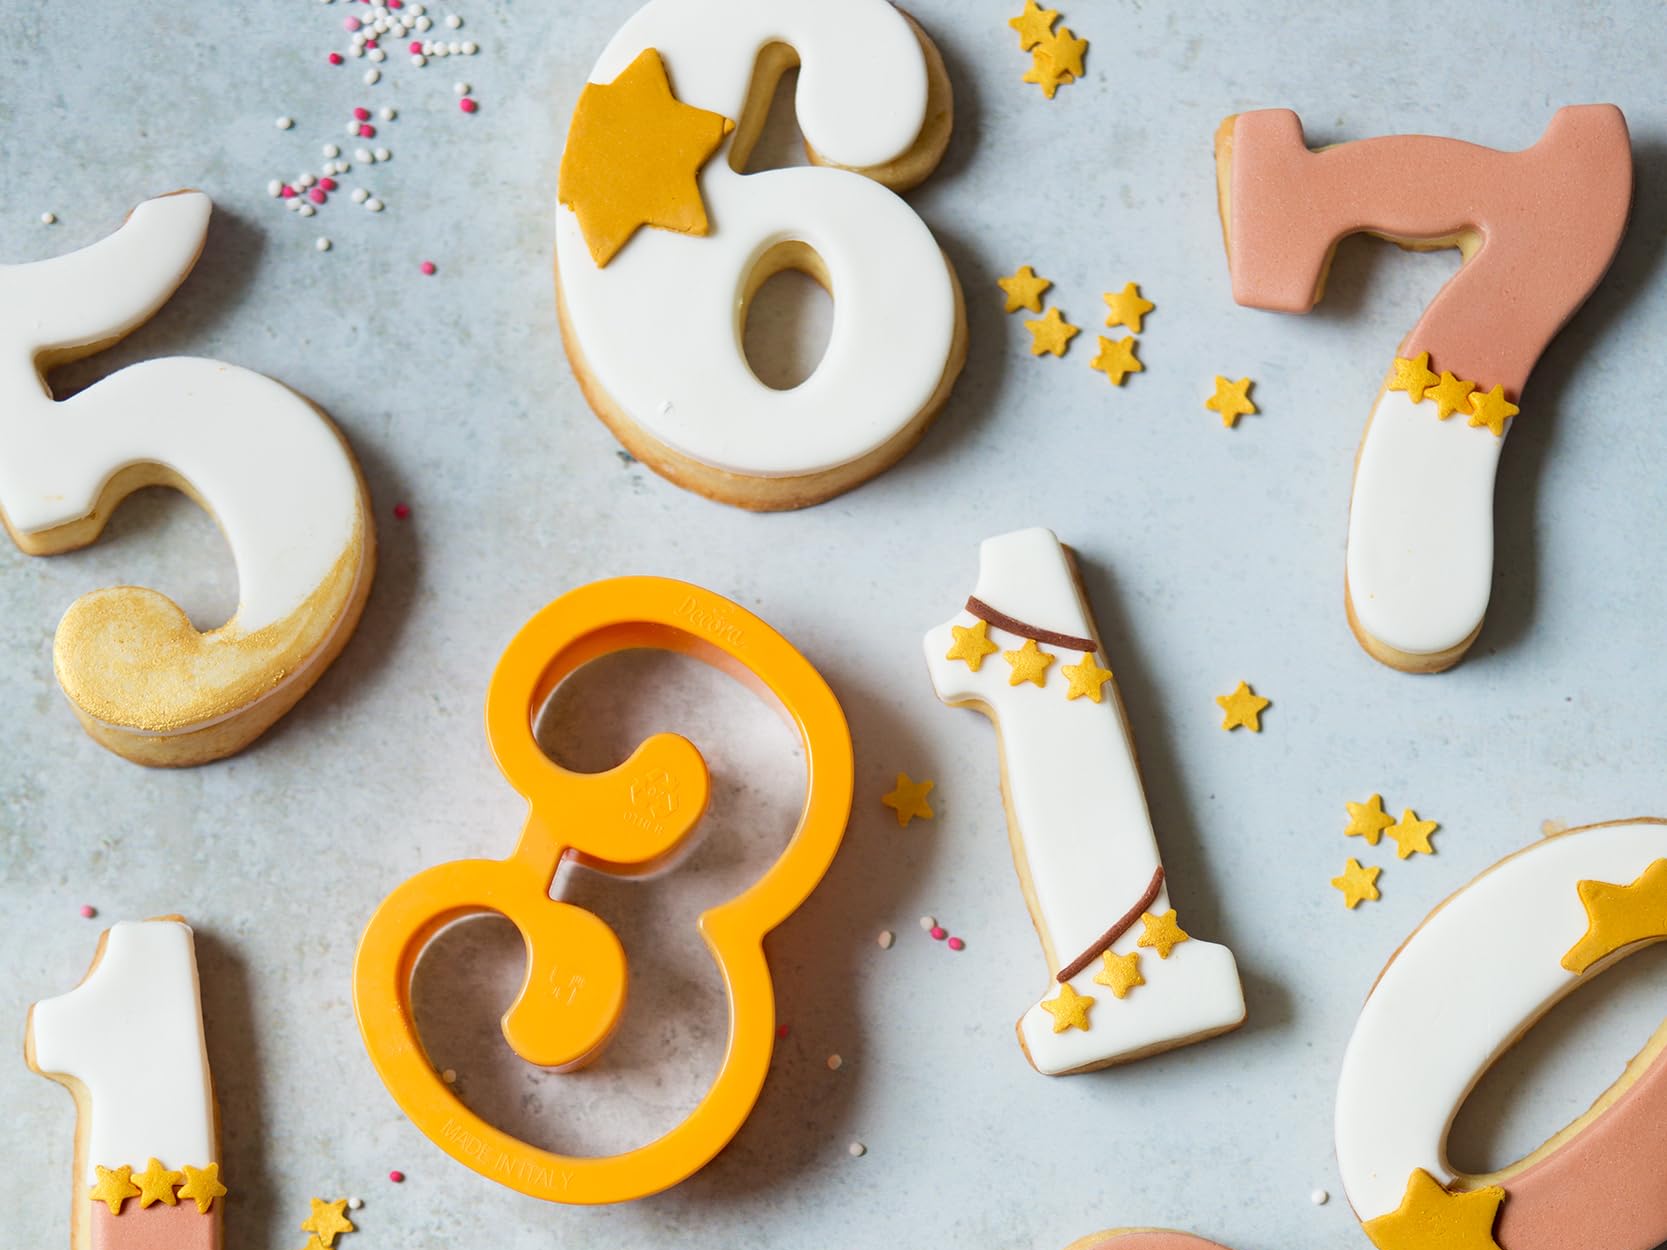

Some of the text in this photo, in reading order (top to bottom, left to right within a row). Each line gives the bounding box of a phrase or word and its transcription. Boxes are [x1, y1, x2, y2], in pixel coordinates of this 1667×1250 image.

[0, 190, 378, 768] 5
[555, 0, 968, 513] 6
[1215, 103, 1634, 674] 7
[923, 527, 1245, 1076] 1
[439, 1118, 575, 1192] MADE IN ITALY
